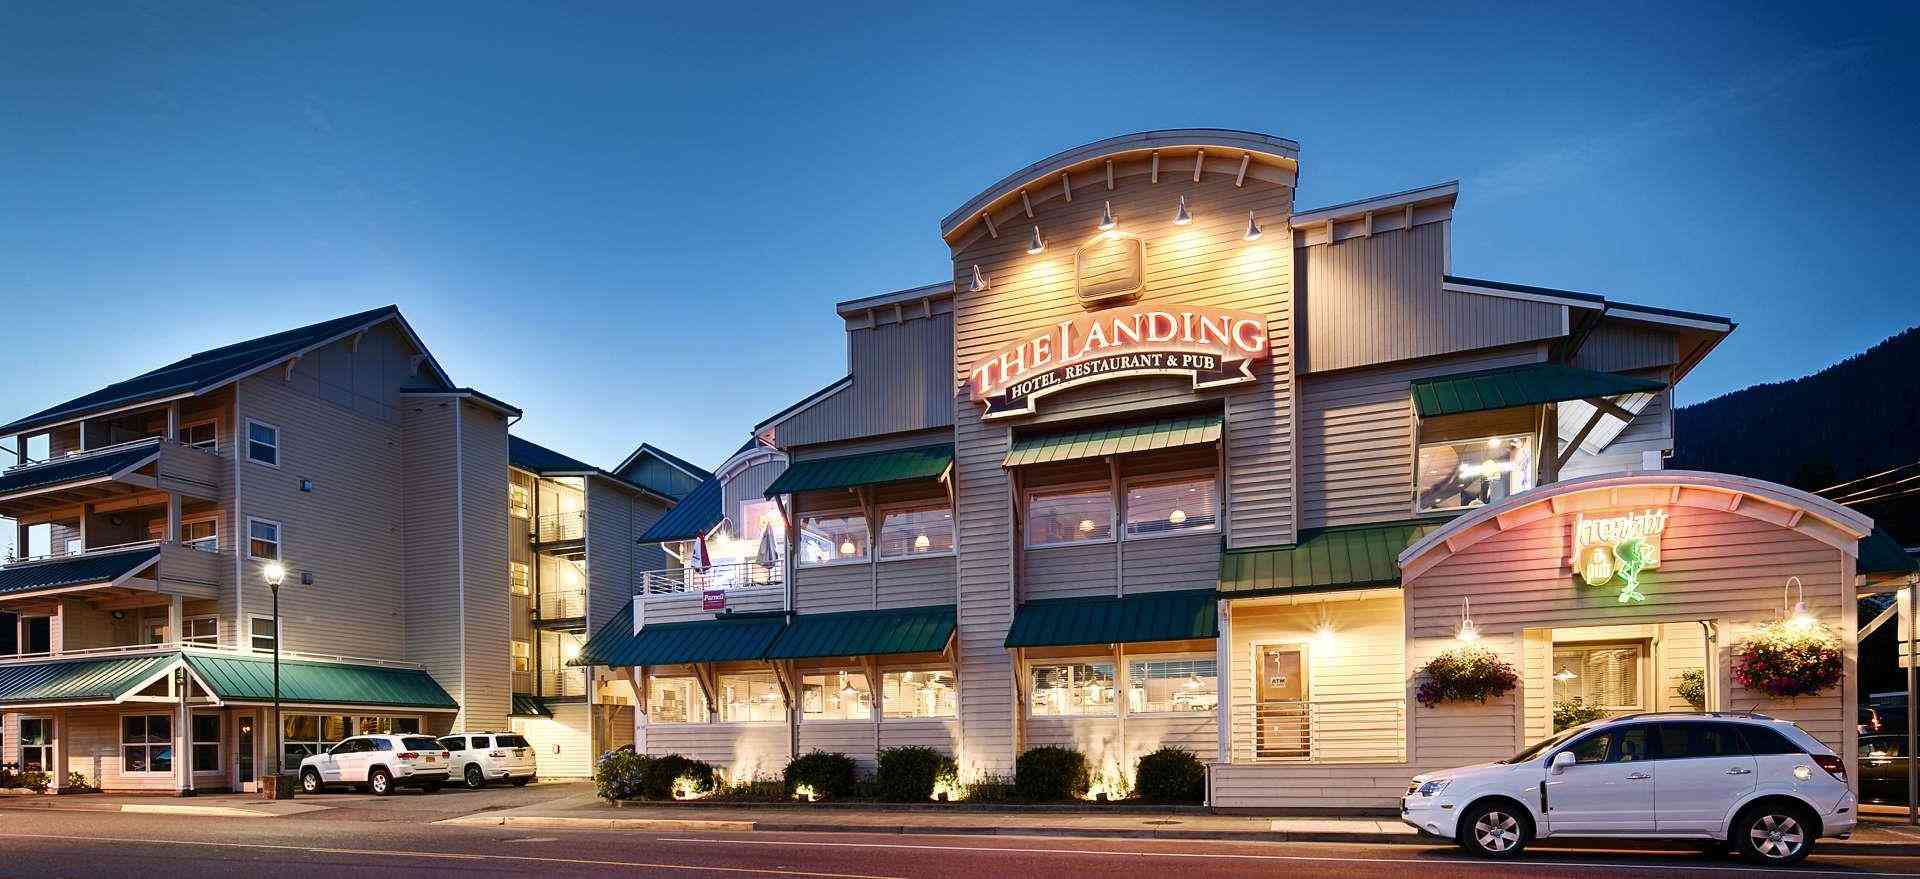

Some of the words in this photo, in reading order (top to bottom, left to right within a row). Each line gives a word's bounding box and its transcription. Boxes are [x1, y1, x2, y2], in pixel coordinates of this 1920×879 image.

[971, 333, 1053, 395] THE
[1058, 310, 1265, 363] LANDING
[1011, 370, 1061, 399] HOTEL,
[1065, 352, 1163, 380] RESTAURANT
[1166, 354, 1178, 367] &
[1183, 354, 1215, 370] PUB
